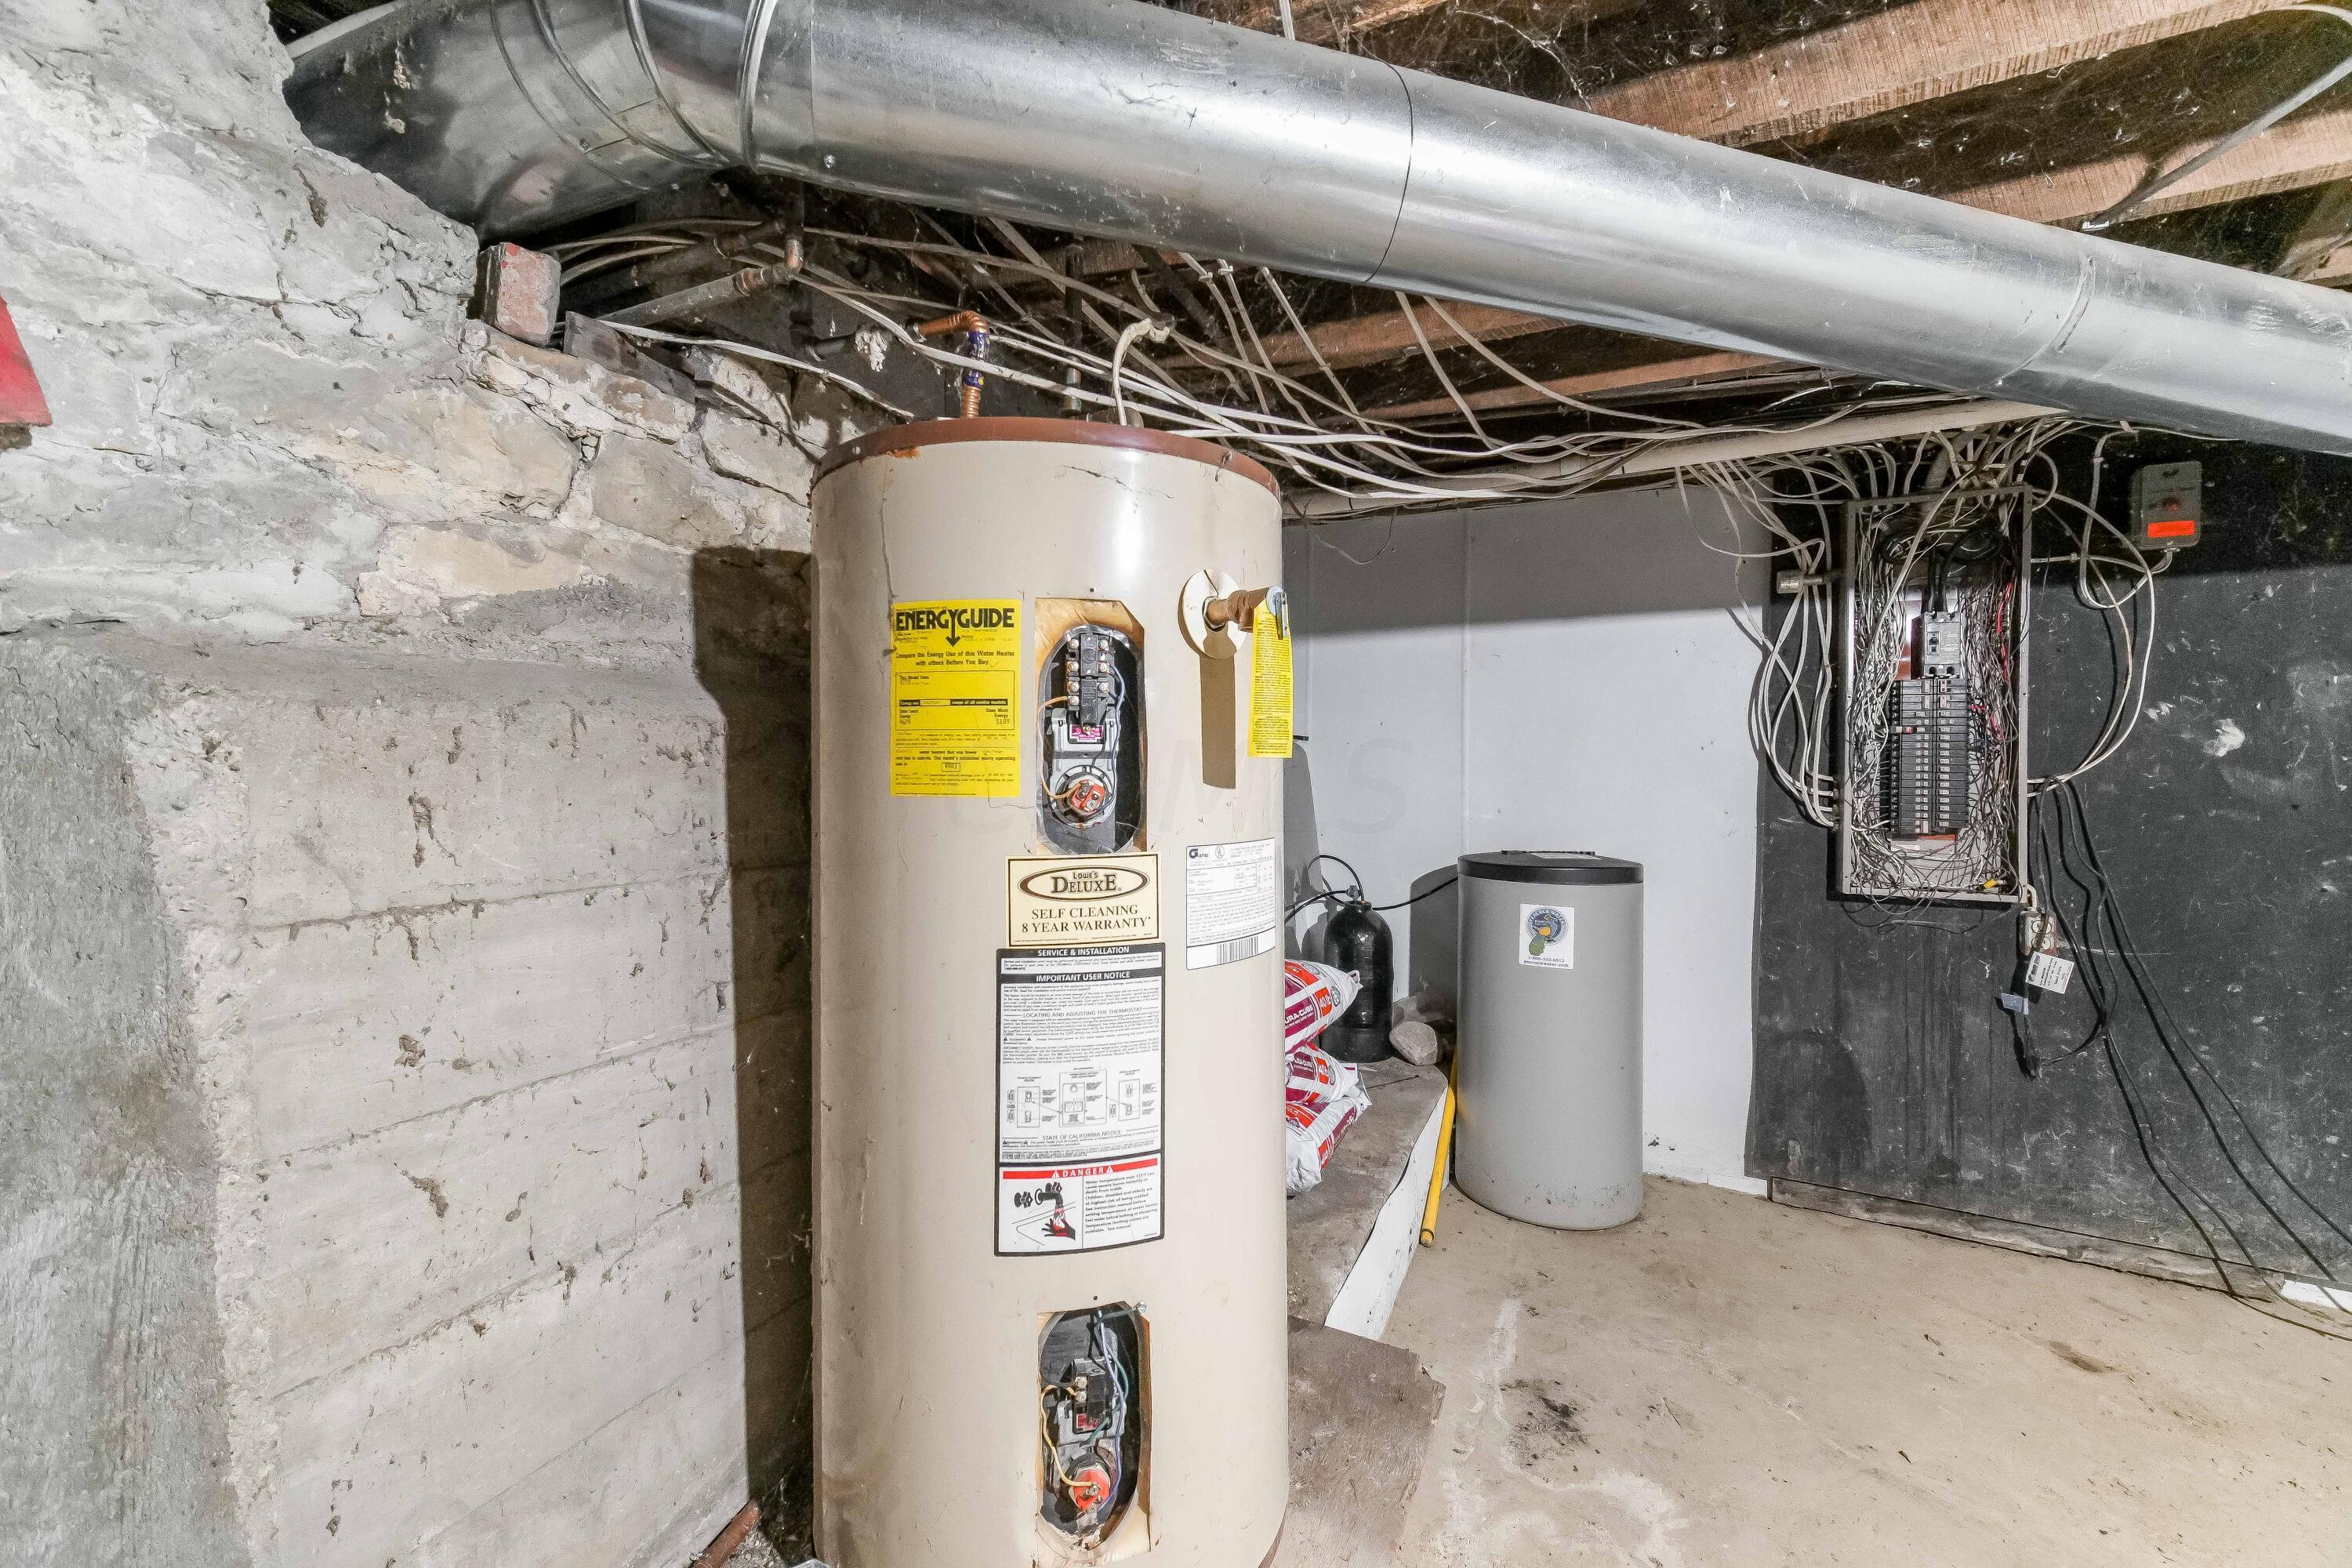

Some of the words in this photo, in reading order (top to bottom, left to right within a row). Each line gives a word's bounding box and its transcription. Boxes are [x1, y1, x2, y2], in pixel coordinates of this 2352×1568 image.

[896, 608, 1015, 632] ENERGYGUIDE
[1051, 873, 1117, 894] DELUXE
[1032, 908, 1065, 920] SELF
[1069, 904, 1138, 918] CLEANING
[1022, 923, 1029, 934] 8
[1032, 921, 1069, 933] YEAR
[1037, 949, 1068, 957] SERVICE
[1077, 946, 1131, 956] INSTALLATION
[1036, 973, 1082, 982] IMPORTANT
[1083, 972, 1102, 981] USER
[1104, 971, 1131, 980] NOTICE
[1062, 1167, 1105, 1178] DANGER
